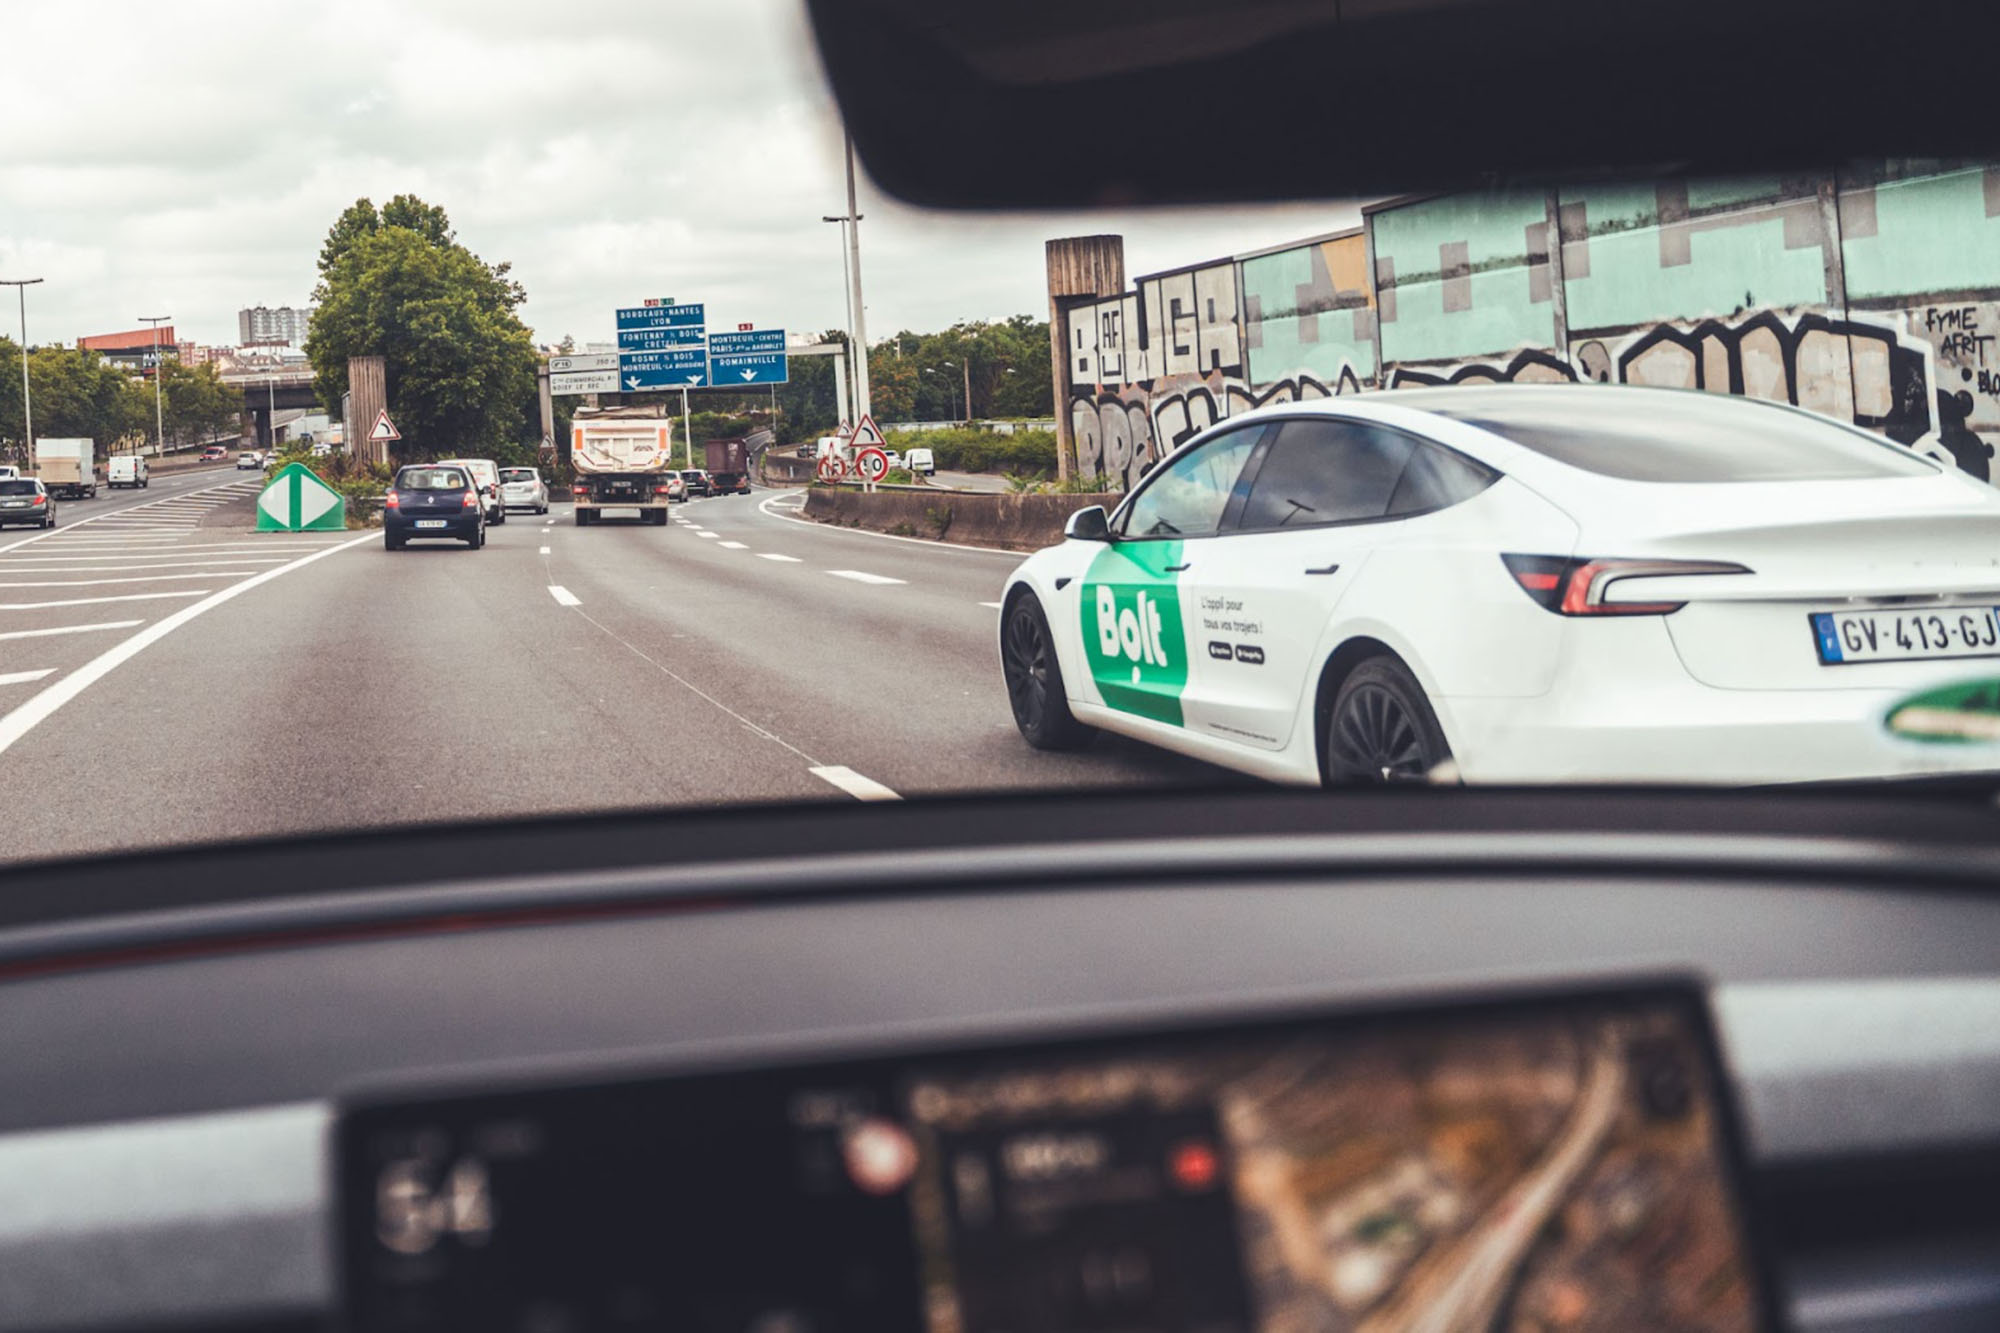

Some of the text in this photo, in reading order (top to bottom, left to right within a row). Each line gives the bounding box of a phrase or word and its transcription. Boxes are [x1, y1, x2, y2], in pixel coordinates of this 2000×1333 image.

[651, 317, 671, 326] LYON
[1926, 307, 1978, 333] FYME
[623, 332, 665, 342] FONTENAY
[632, 355, 659, 363] ROSNY
[674, 352, 694, 360] BOIS
[720, 355, 776, 366] ROMAINVILLE
[1226, 600, 1243, 613] pour
[1096, 584, 1168, 670] Bolt
[1203, 618, 1219, 630] tous
[1220, 621, 1232, 631] vos
[1233, 620, 1258, 636] trajets
[1842, 613, 1996, 652] GV-413-GJ
